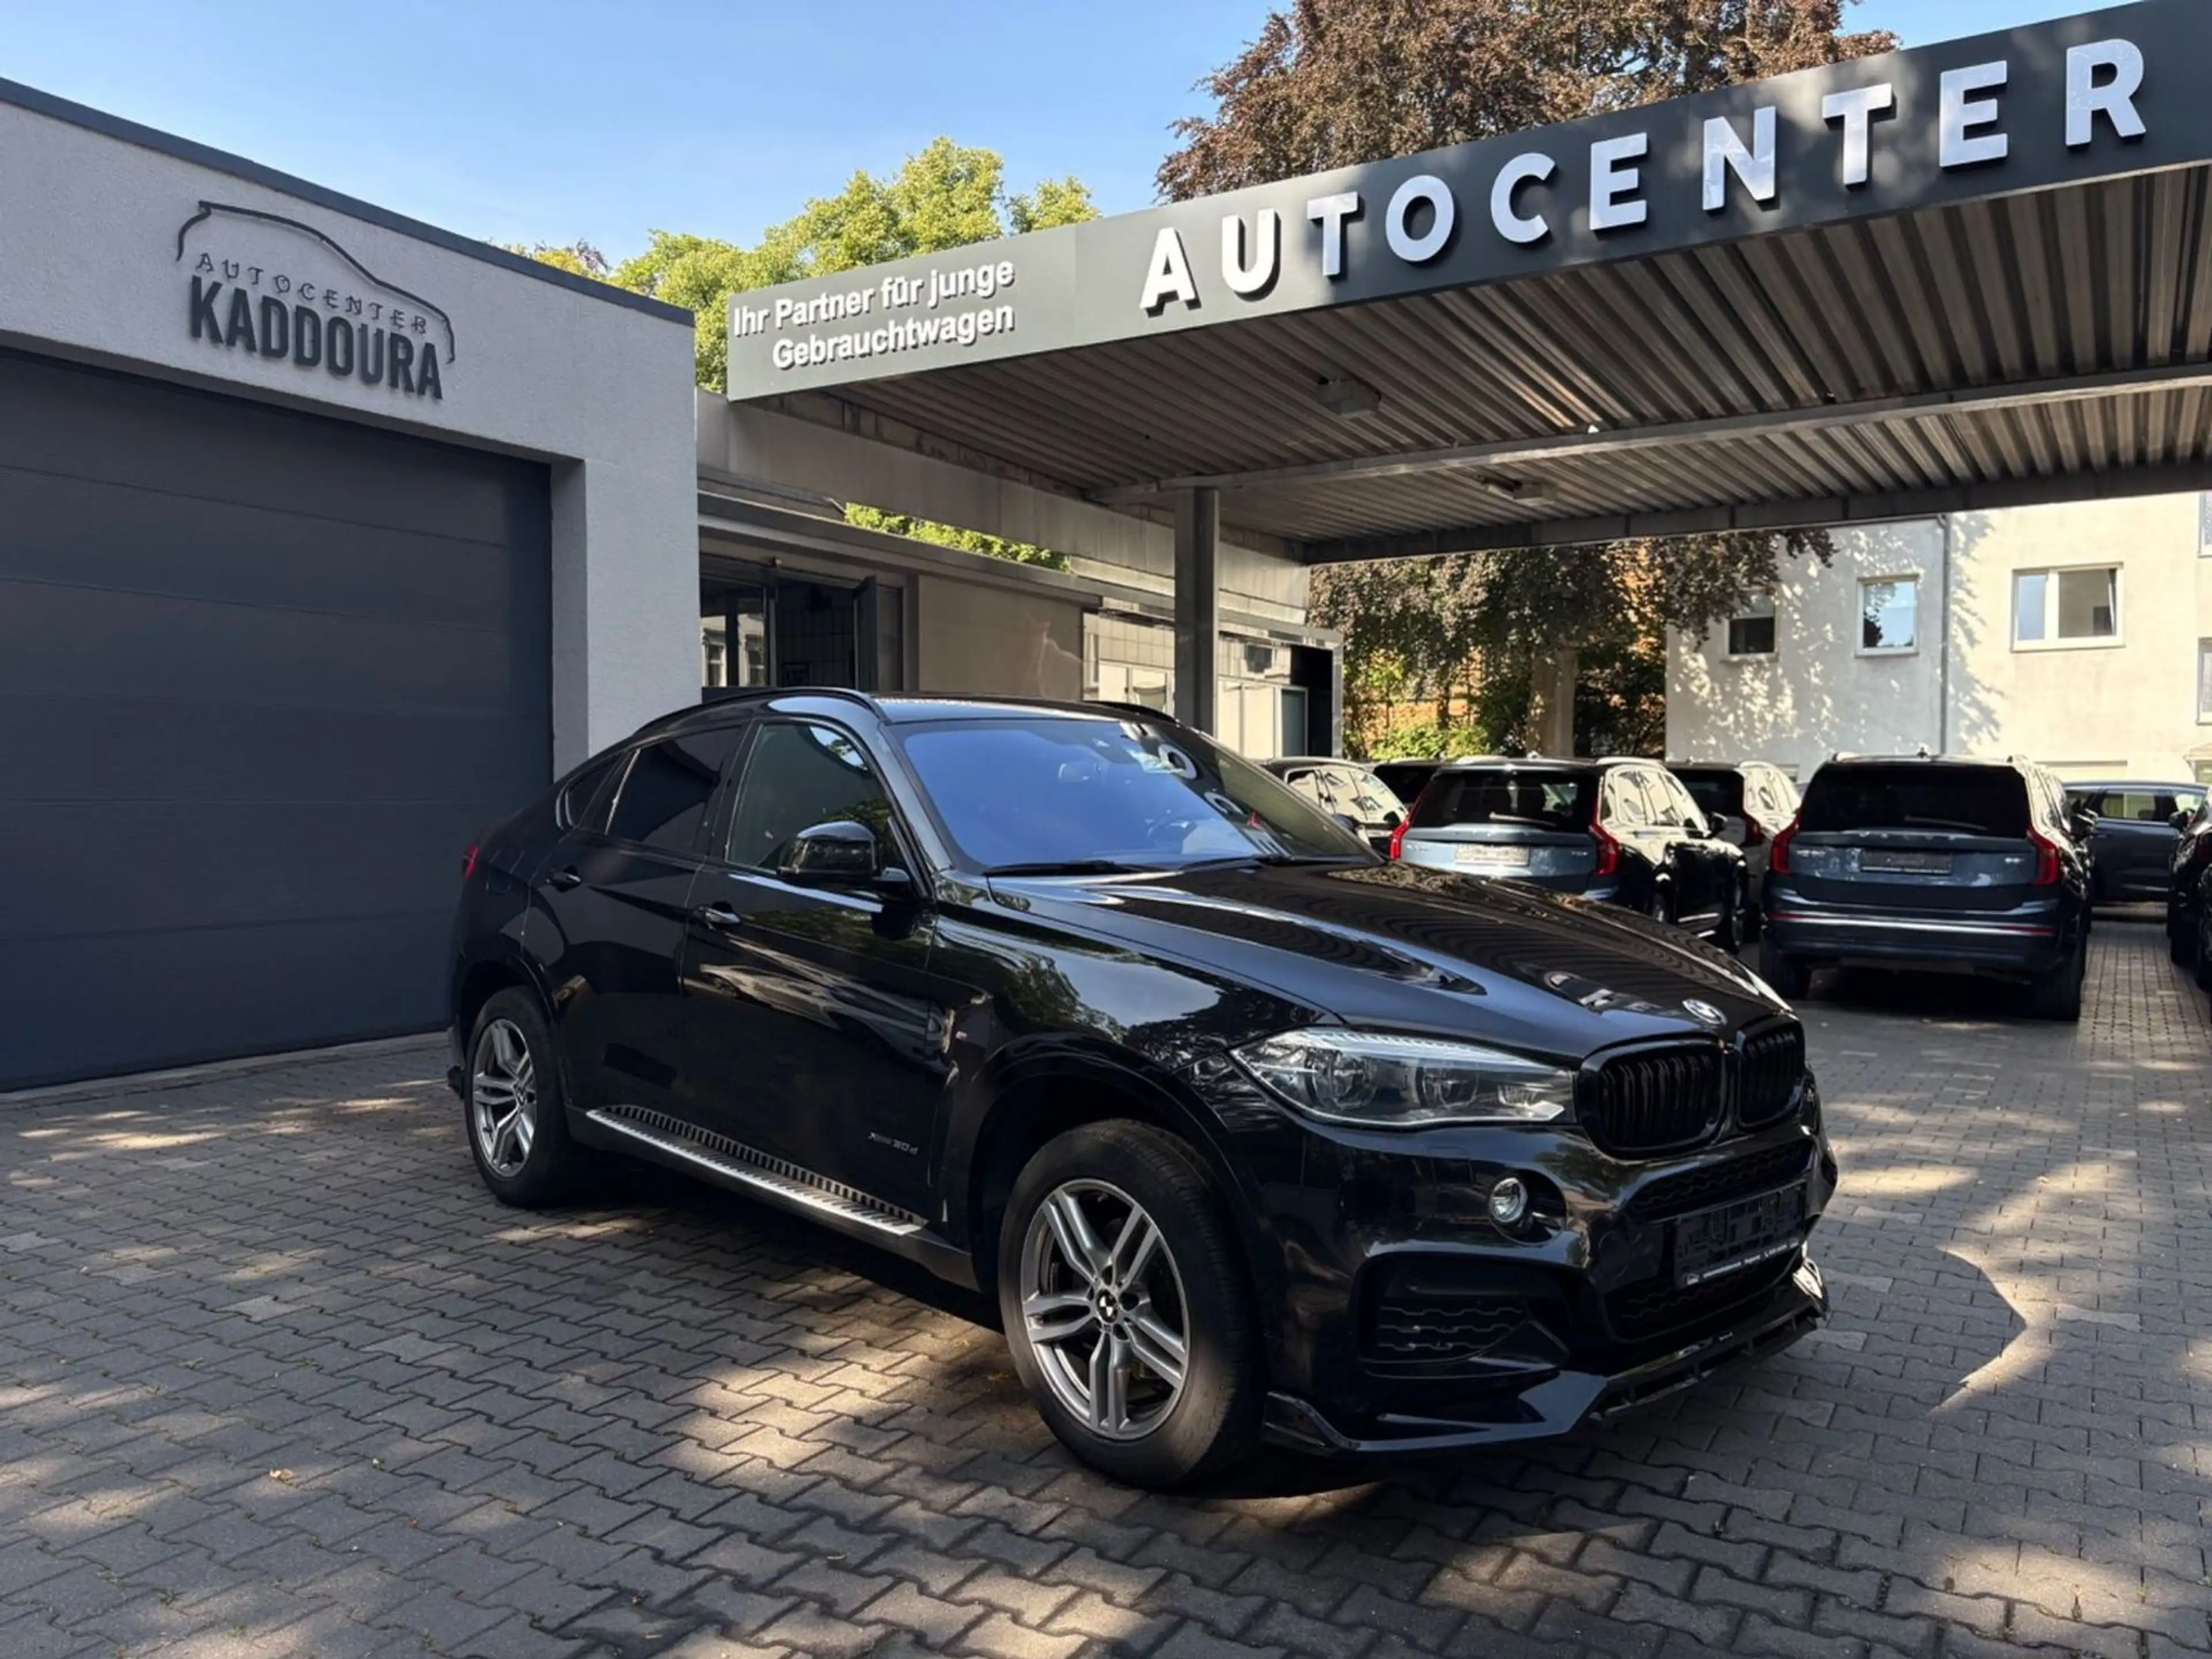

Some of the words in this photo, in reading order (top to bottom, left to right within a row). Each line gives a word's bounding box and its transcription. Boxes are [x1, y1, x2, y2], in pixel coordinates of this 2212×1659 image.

[1139, 38, 2147, 313] AUTOCENTER
[195, 252, 427, 335] AUTOCENTER
[734, 306, 770, 336] Ihr
[775, 286, 876, 329] Partner
[881, 276, 924, 309] für
[928, 260, 1016, 309] junge
[191, 275, 443, 400] KADDOURA
[772, 305, 1016, 370] Gebrauchtwagen
